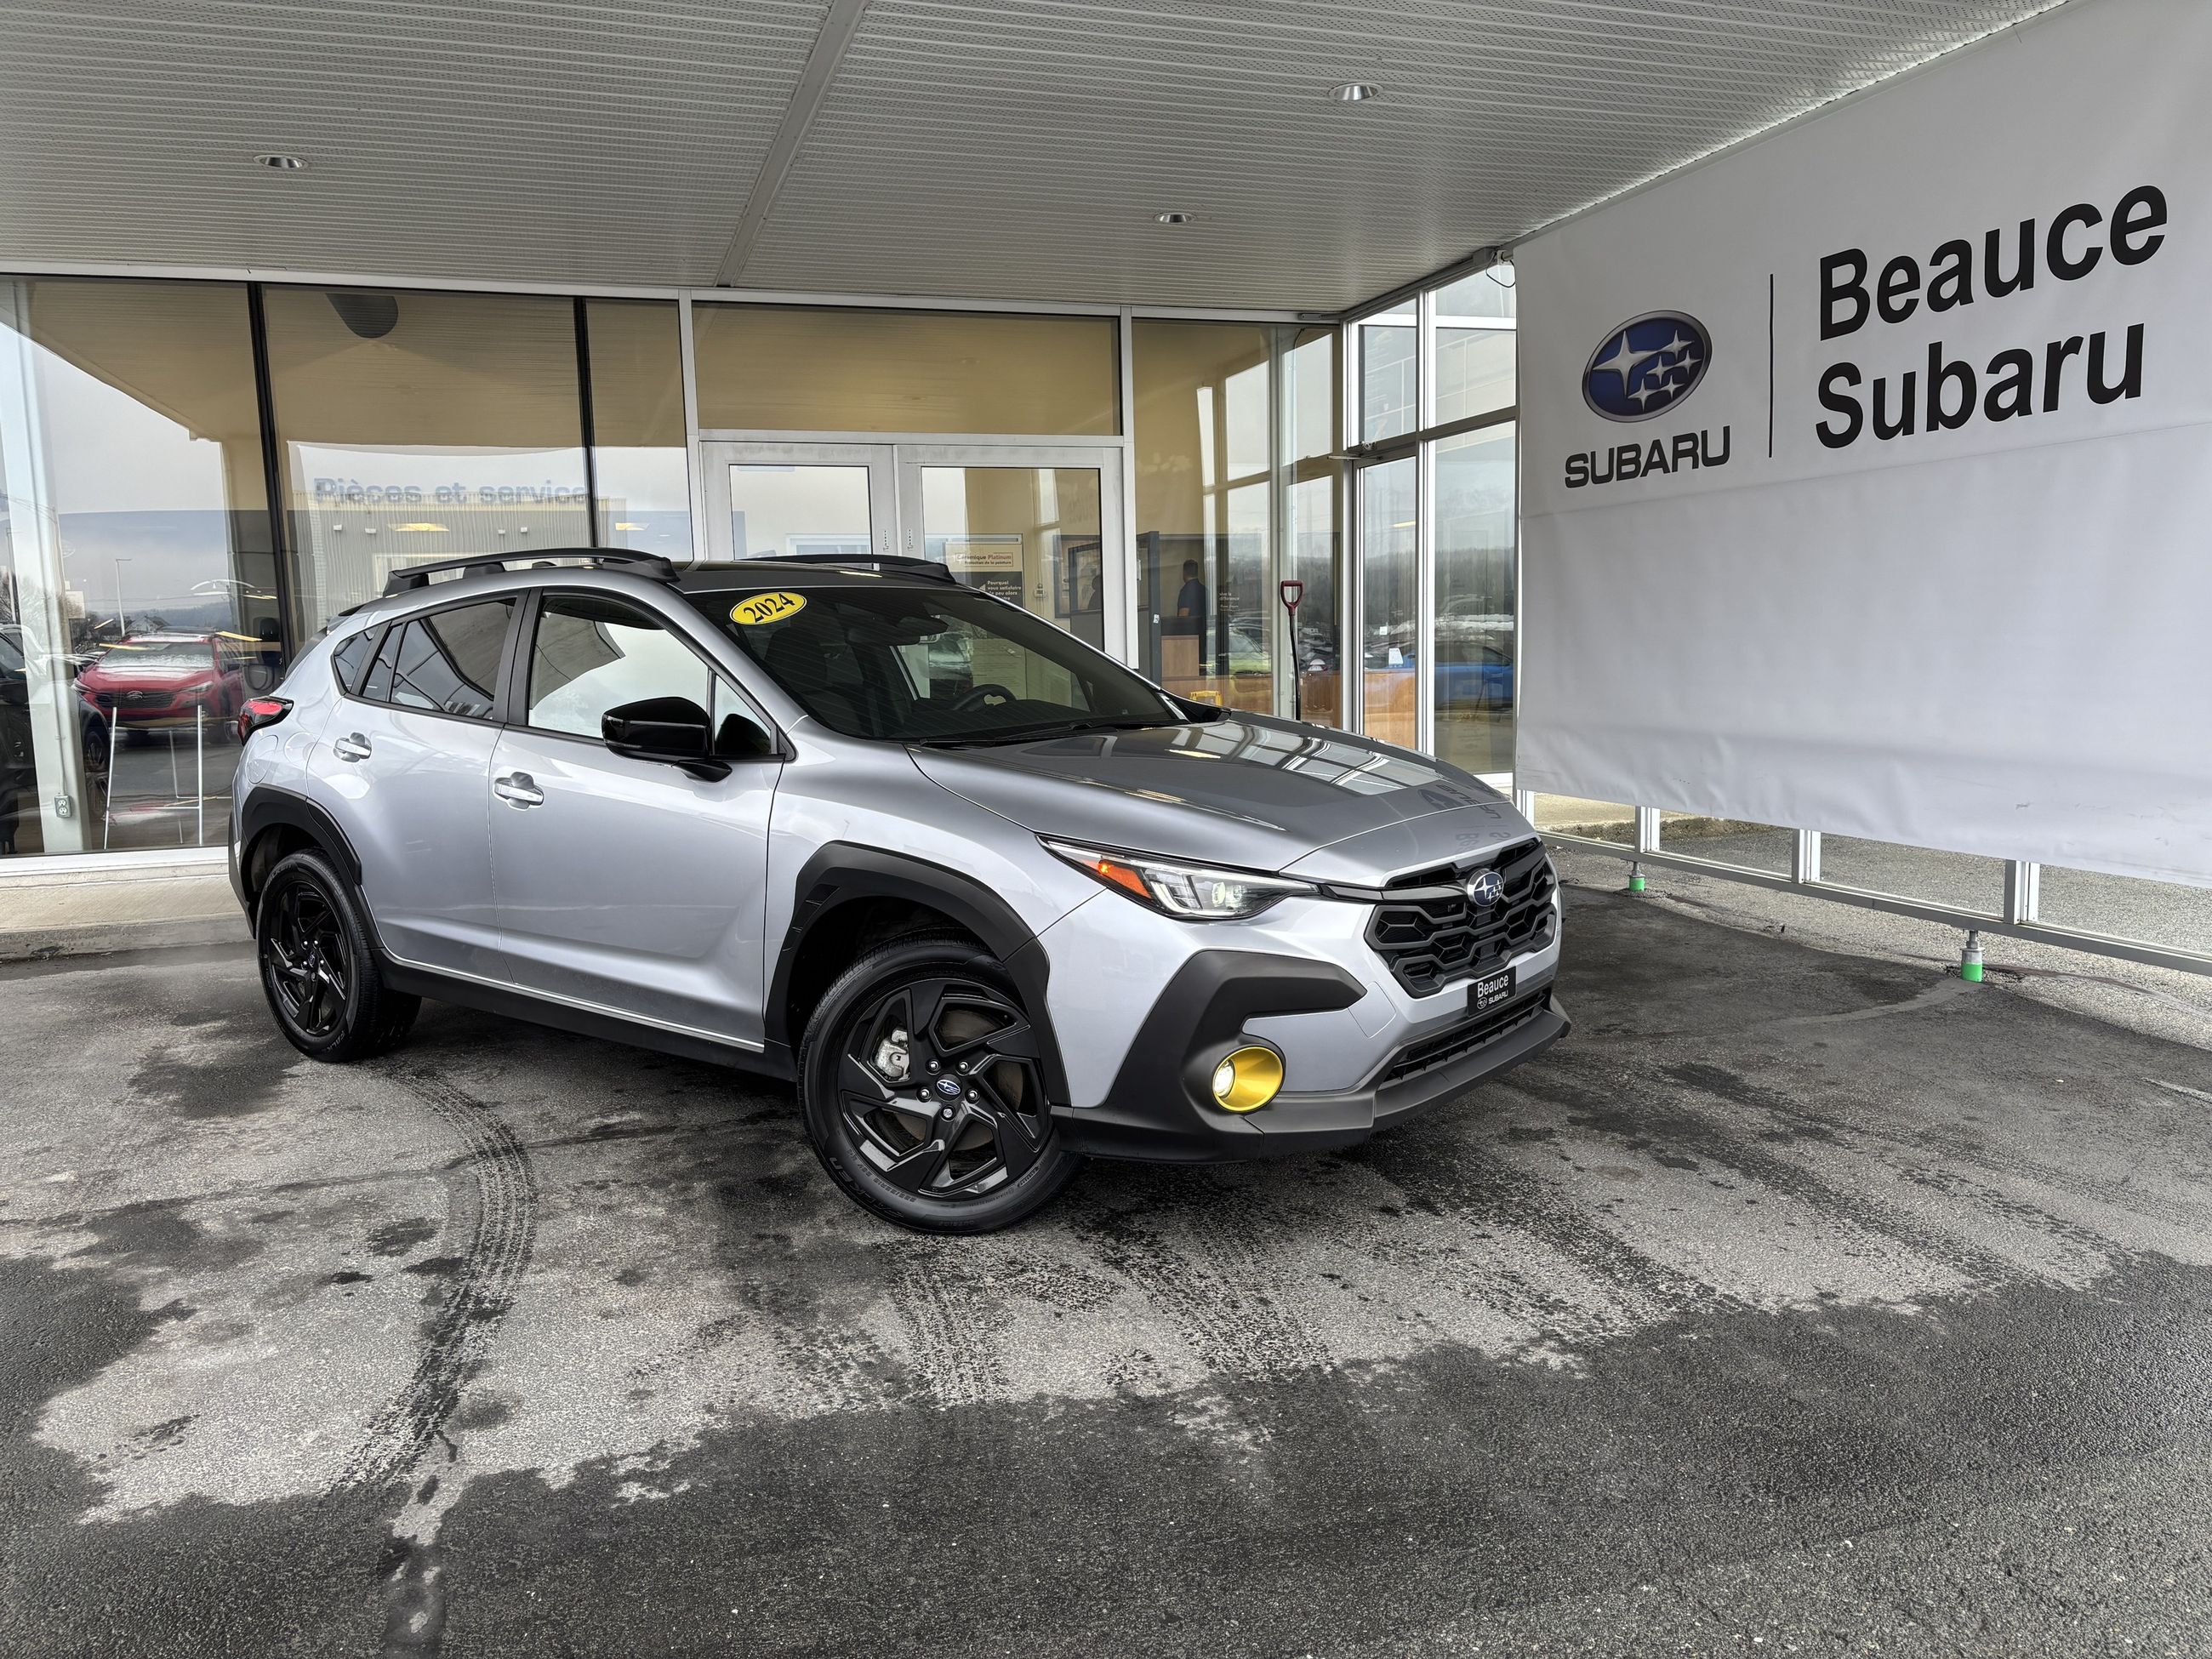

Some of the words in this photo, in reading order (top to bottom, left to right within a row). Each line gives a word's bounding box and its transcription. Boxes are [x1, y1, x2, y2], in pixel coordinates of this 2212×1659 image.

[1820, 185, 2168, 341] Beauce
[1816, 322, 2145, 449] Subaru
[1565, 425, 1730, 488] SUBARU
[435, 482, 467, 505] et
[743, 593, 795, 623] 2024
[1477, 974, 1509, 999] Beauce
[1488, 989, 1509, 1005] SUBARU
